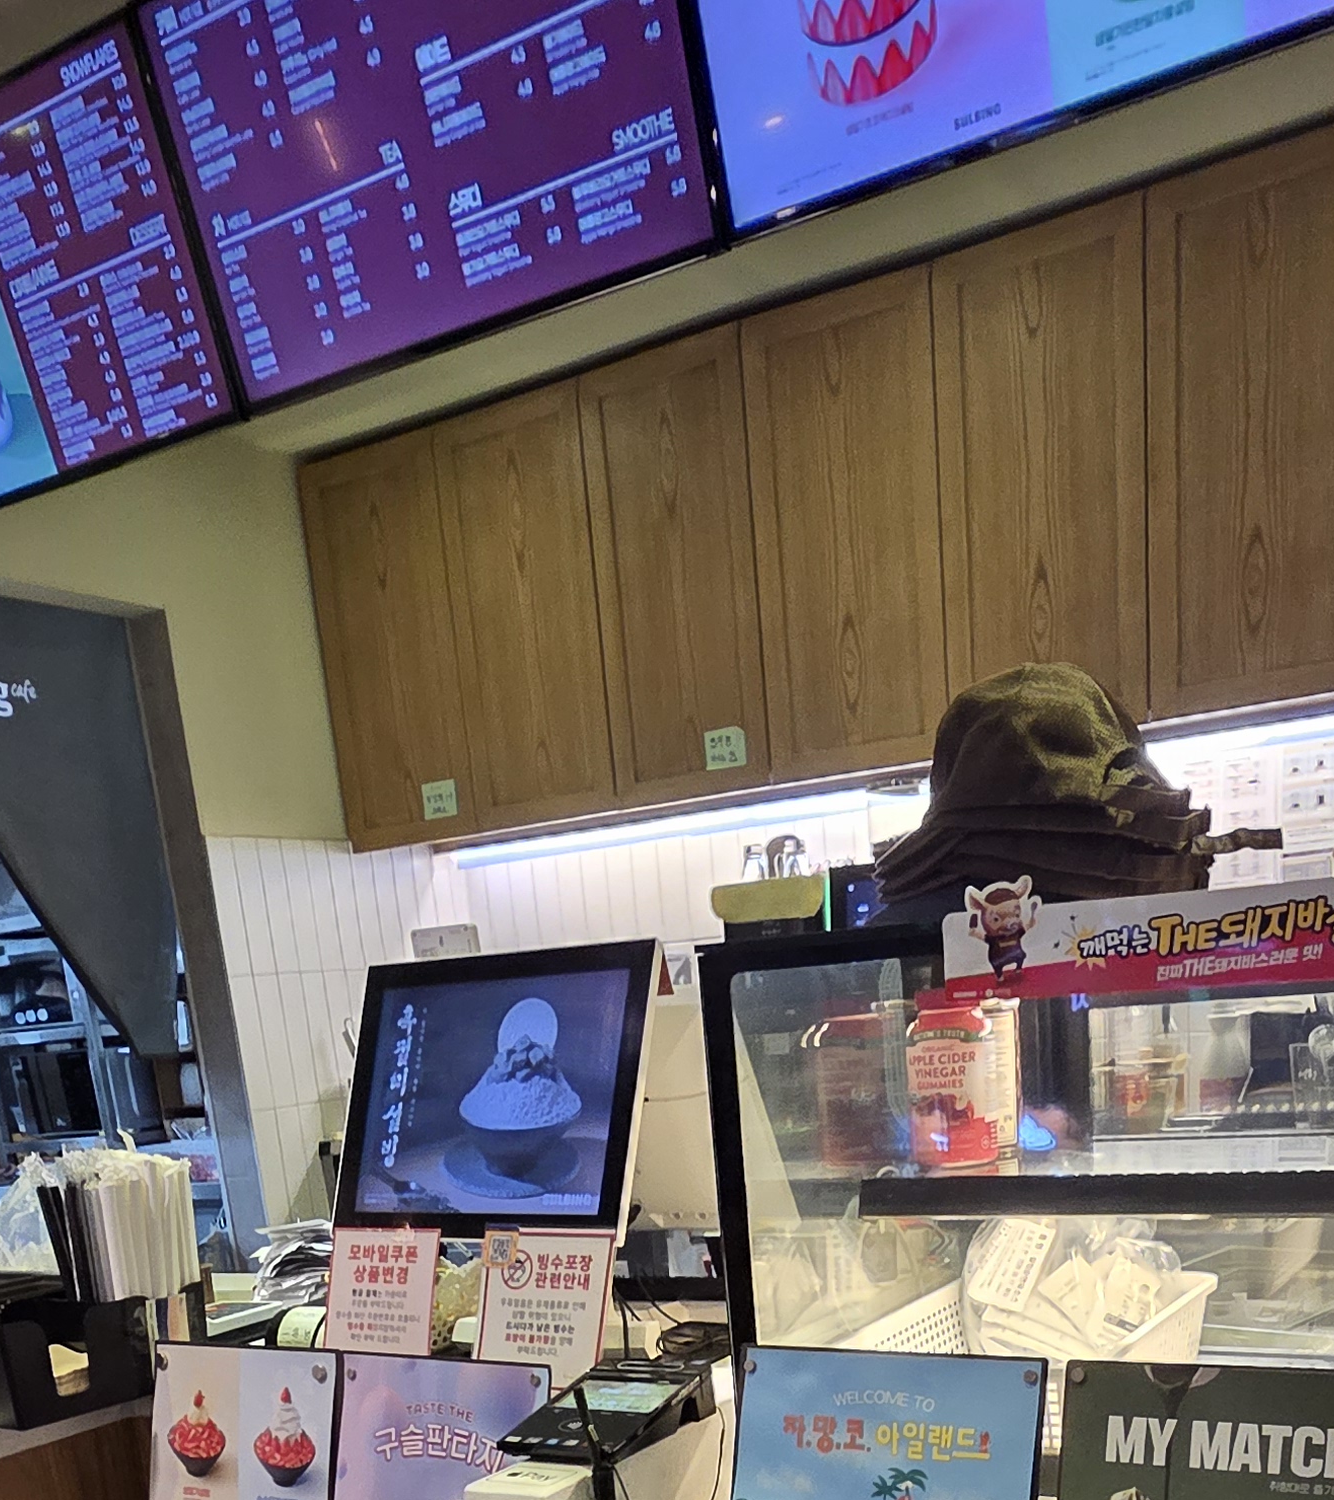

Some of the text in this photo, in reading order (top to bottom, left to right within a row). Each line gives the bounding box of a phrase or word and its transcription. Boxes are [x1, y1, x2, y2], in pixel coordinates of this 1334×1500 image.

[612, 106, 675, 152] SMOOTHIE
[938, 1051, 976, 1064] CIDER
[915, 1065, 966, 1079] VINEGAR
[917, 1079, 964, 1090] GUMMIES
[348, 1244, 418, 1263] 모바일쿠폰
[537, 1253, 593, 1272] 빙수포장
[353, 1265, 409, 1284] 상품변경
[535, 1272, 590, 1290] 관련안내
[833, 1389, 936, 1412] WELCOME TO
[406, 1403, 474, 1422] TASTE THE
[1105, 1415, 1178, 1467] MY
[524, 1471, 559, 1483] Pay
